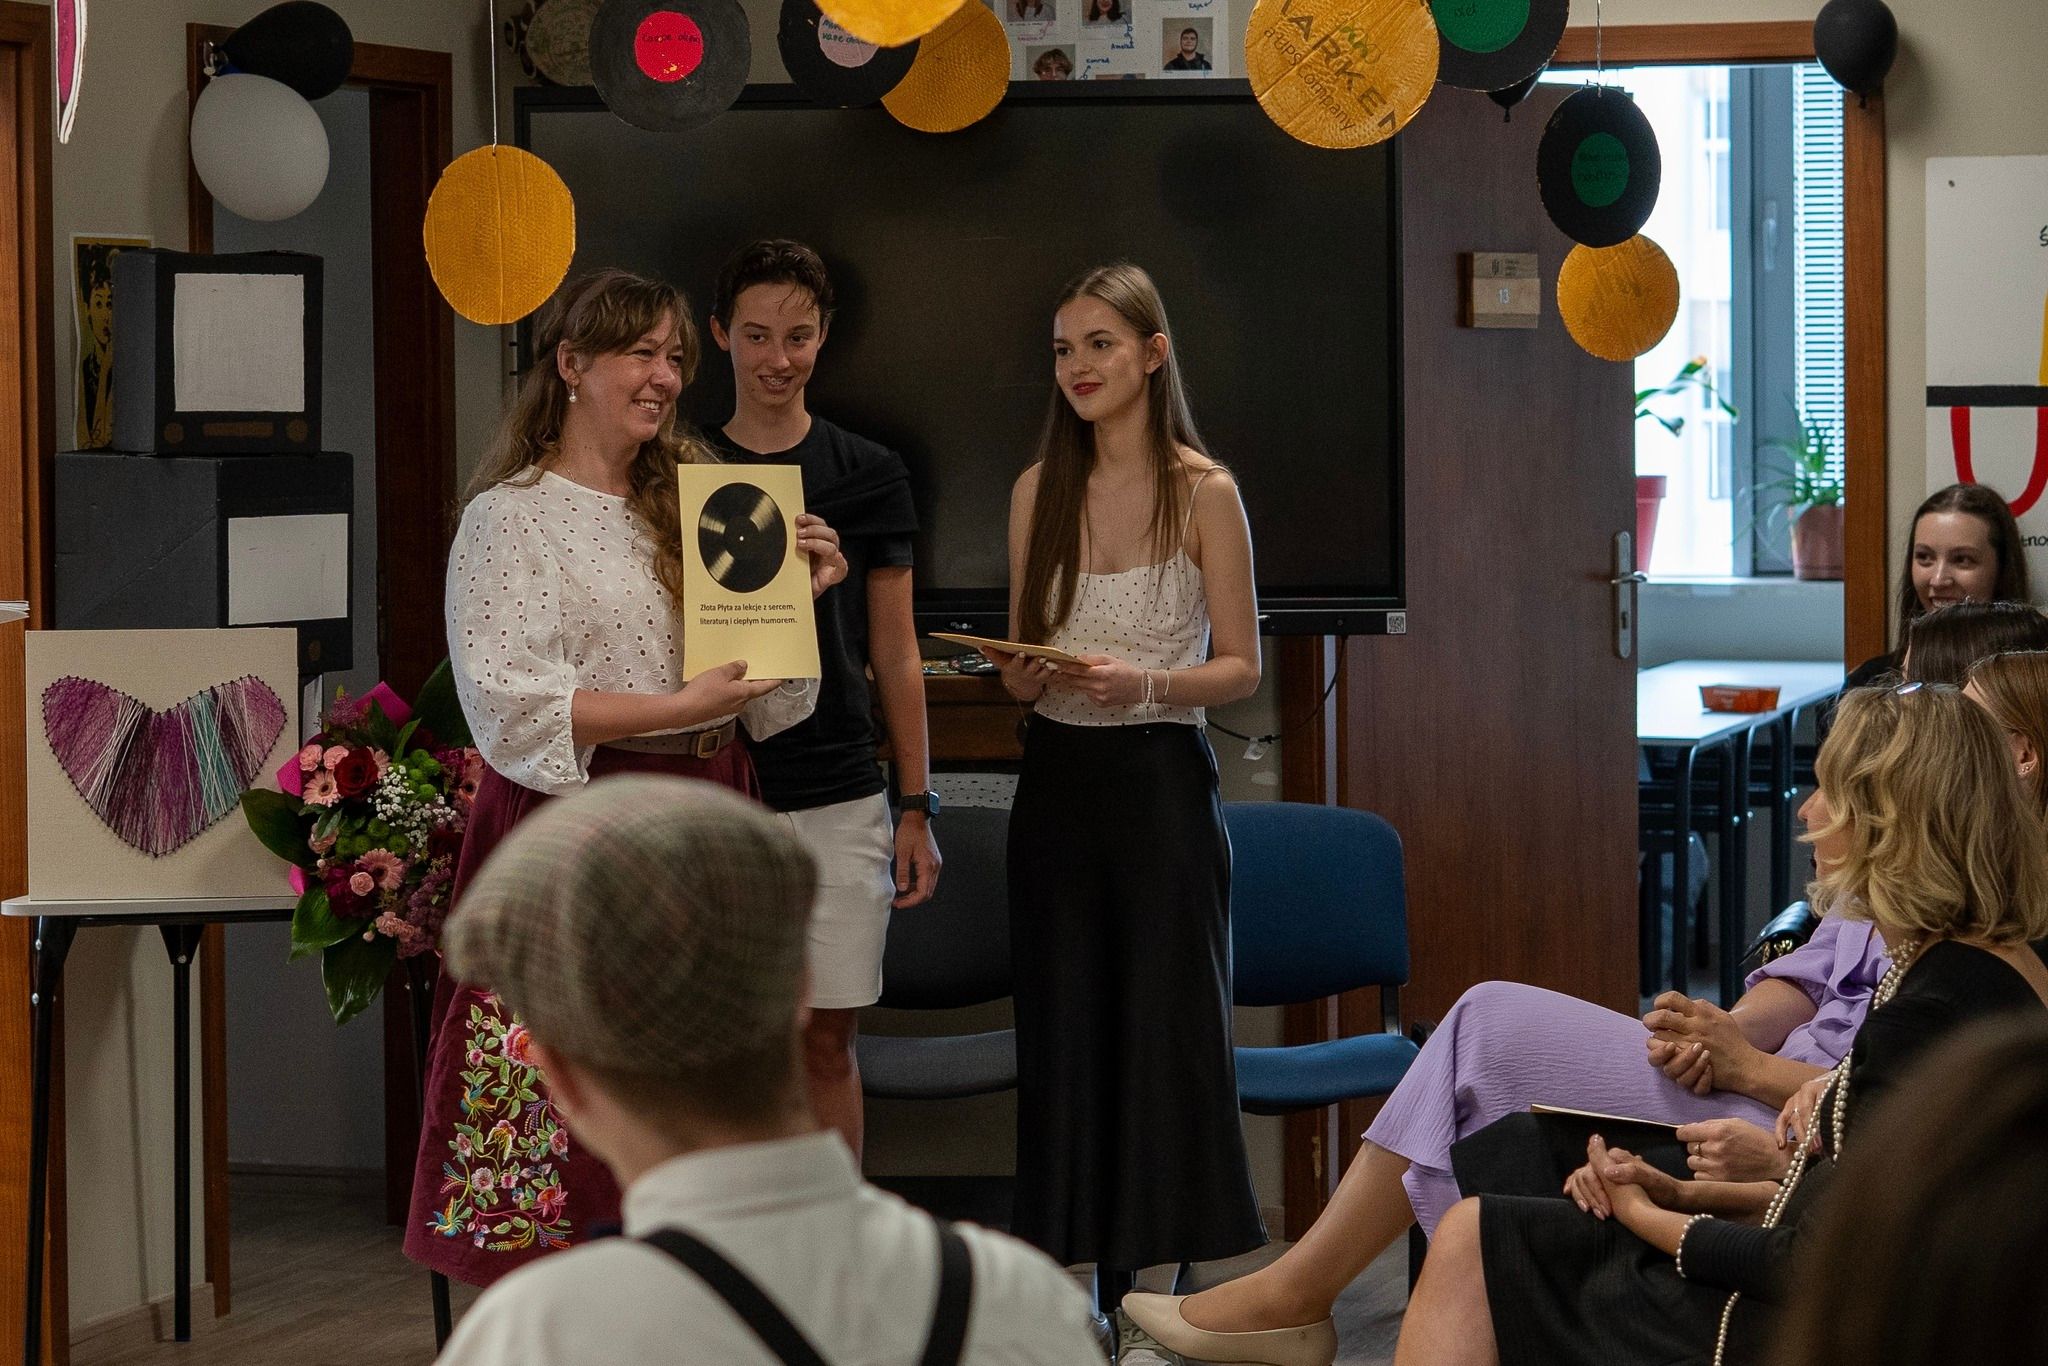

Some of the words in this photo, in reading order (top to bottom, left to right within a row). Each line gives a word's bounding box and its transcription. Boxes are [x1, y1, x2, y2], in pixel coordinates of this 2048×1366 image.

[717, 604, 733, 612] Płyta
[742, 603, 762, 612] lekcje
[768, 603, 796, 611] sercem,
[700, 617, 729, 626] literaturą
[733, 617, 760, 626] ciepłym
